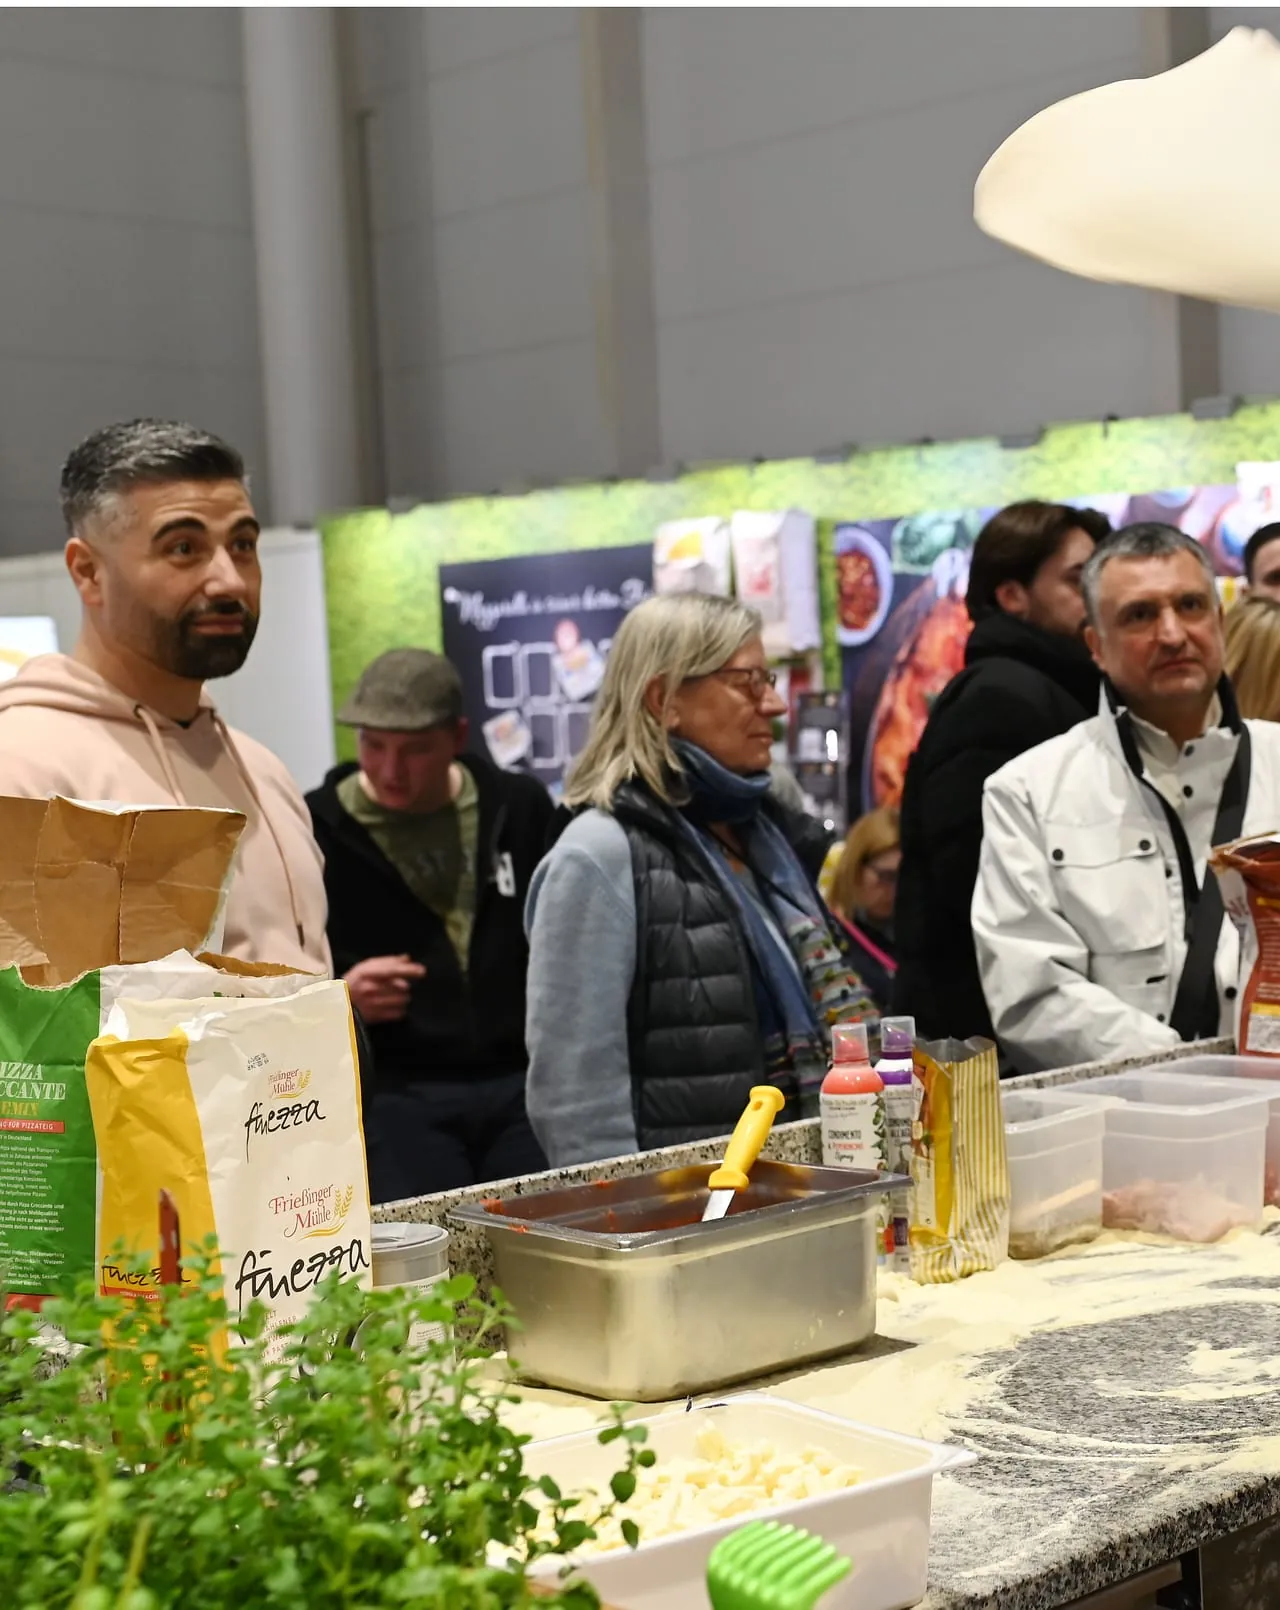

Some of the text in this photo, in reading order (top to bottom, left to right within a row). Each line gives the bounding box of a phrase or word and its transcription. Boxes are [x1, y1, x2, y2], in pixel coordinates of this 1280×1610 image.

[21, 1122, 54, 1130] PIZZATEIG
[244, 1099, 327, 1164] finezza
[269, 1184, 334, 1214] Frießinger
[284, 1206, 331, 1237] Mühle
